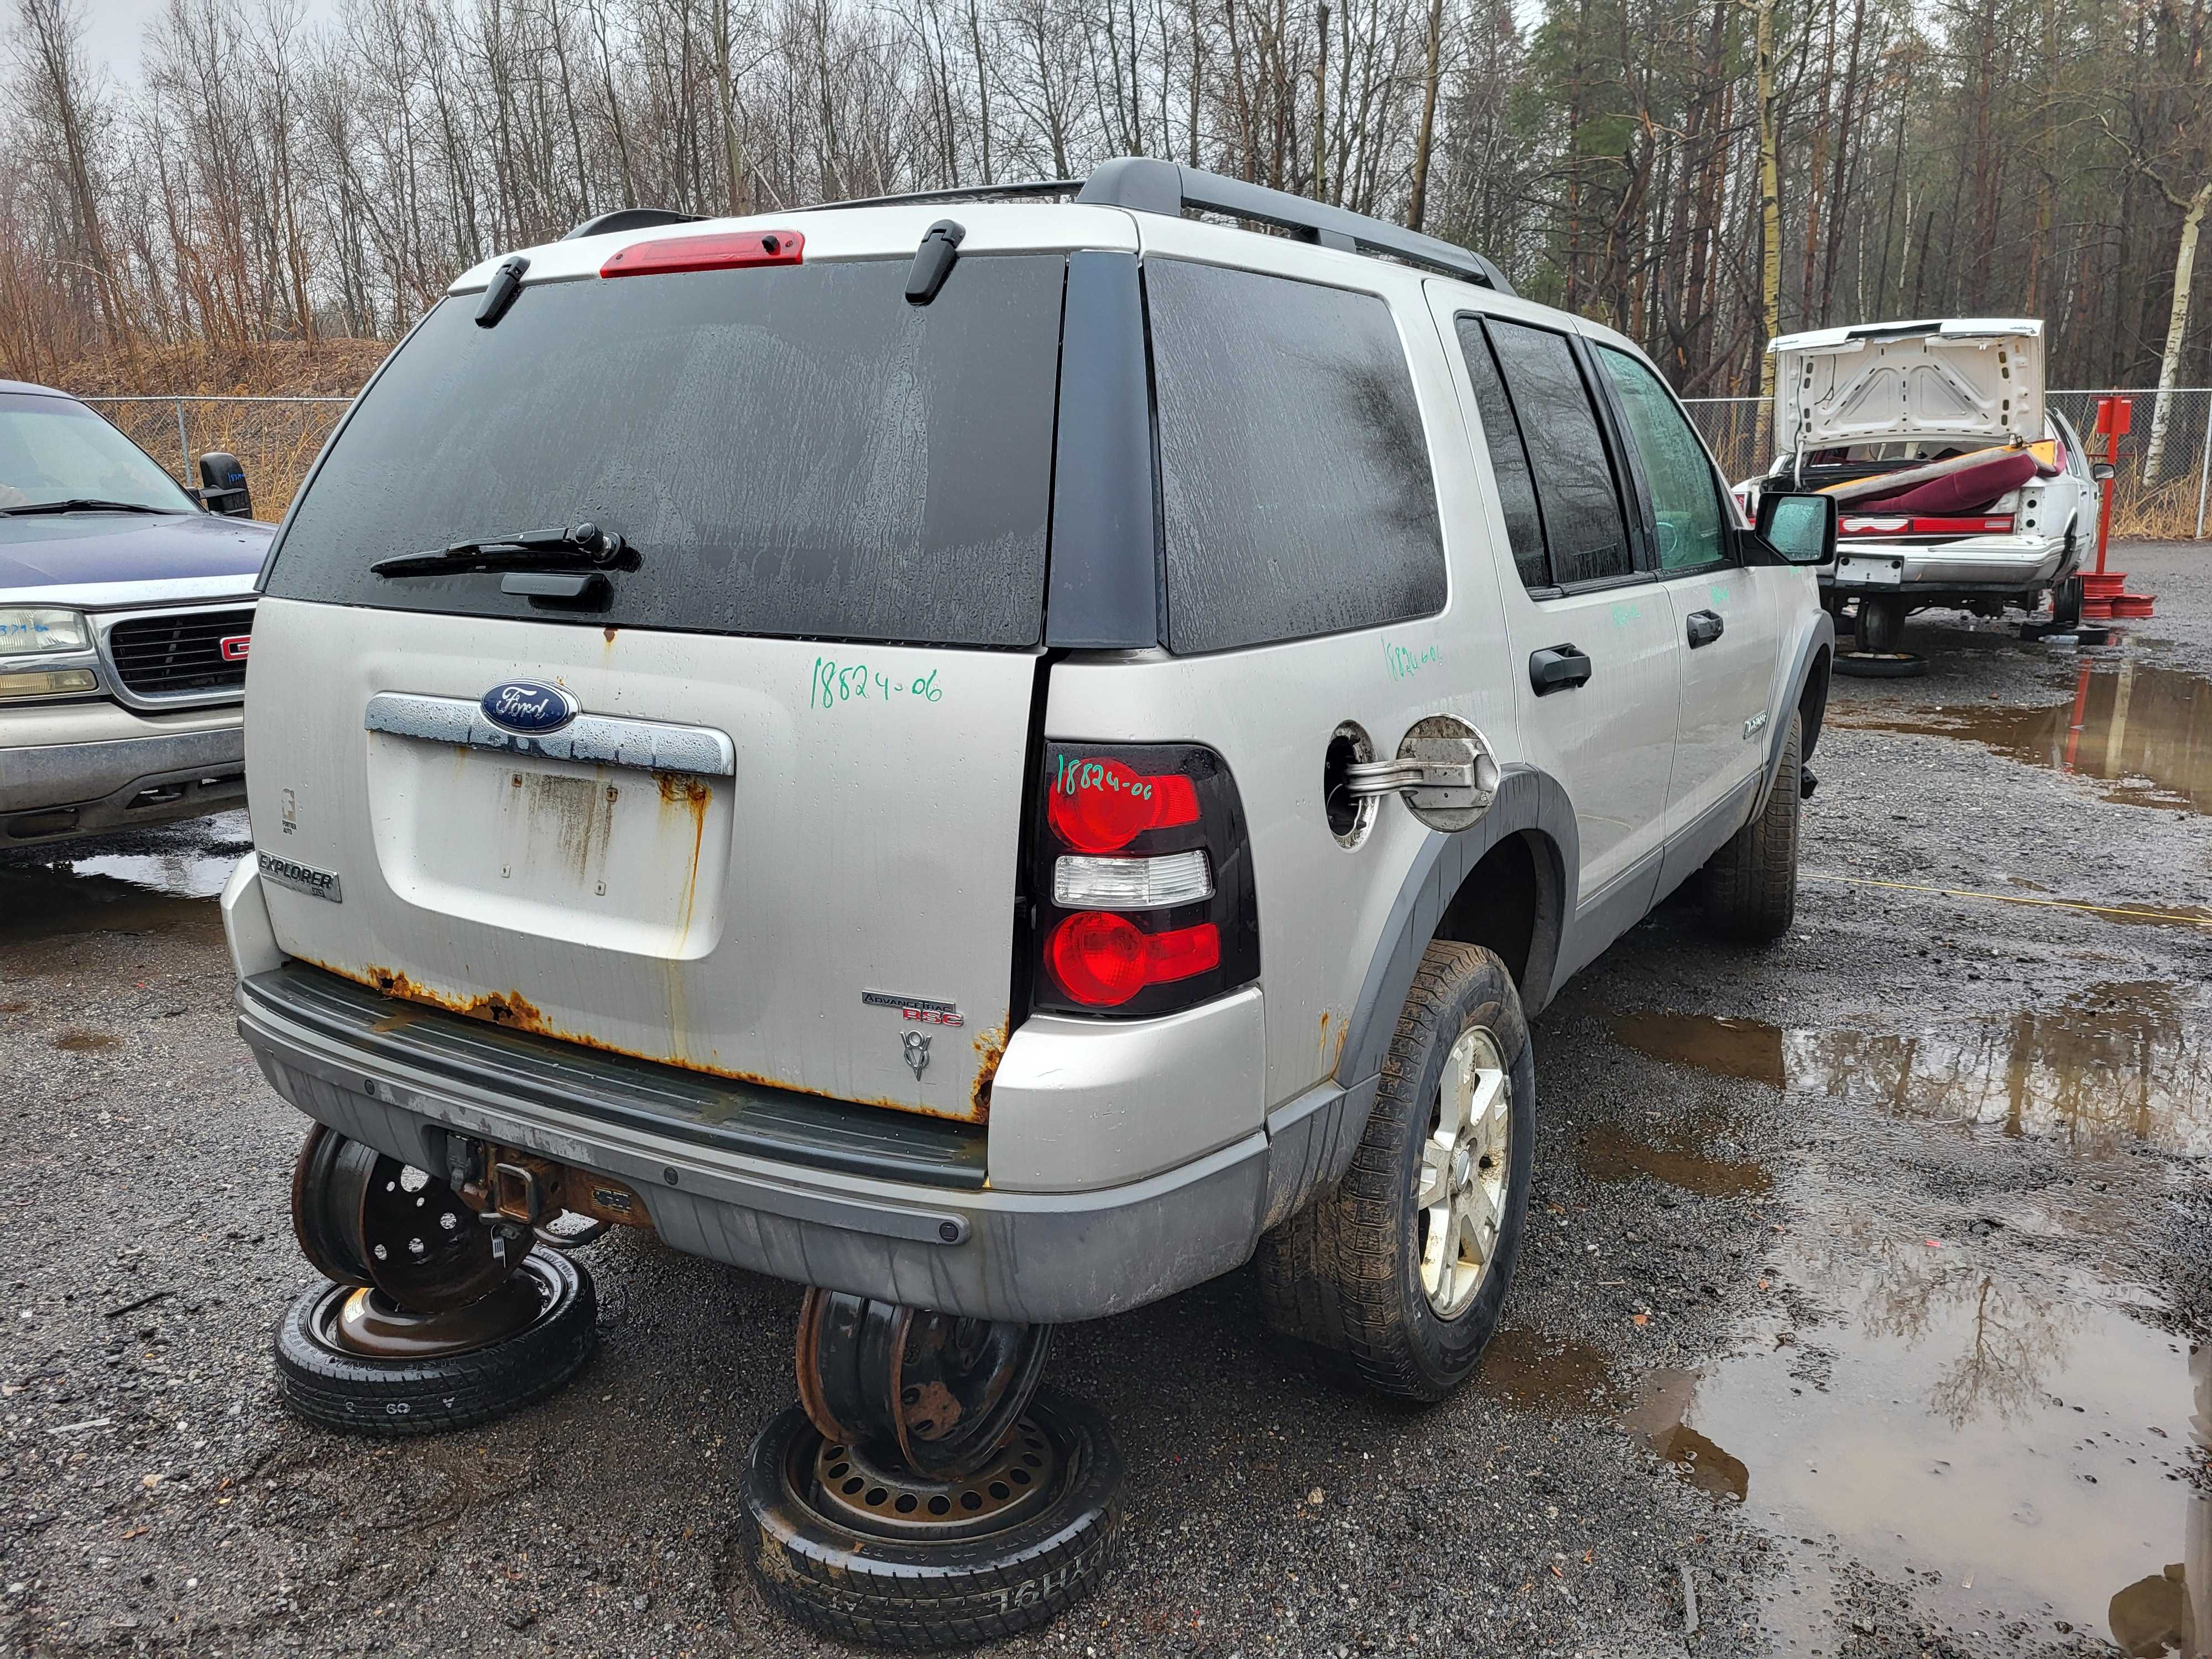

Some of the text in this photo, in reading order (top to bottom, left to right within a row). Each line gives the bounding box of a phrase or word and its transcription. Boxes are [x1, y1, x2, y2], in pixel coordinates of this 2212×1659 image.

[811, 657, 943, 709] 18824-06
[495, 686, 550, 719] Ford
[1057, 754, 1152, 800] 18824-06
[259, 854, 333, 890] EXPLORER
[902, 1006, 964, 1027] RSC
